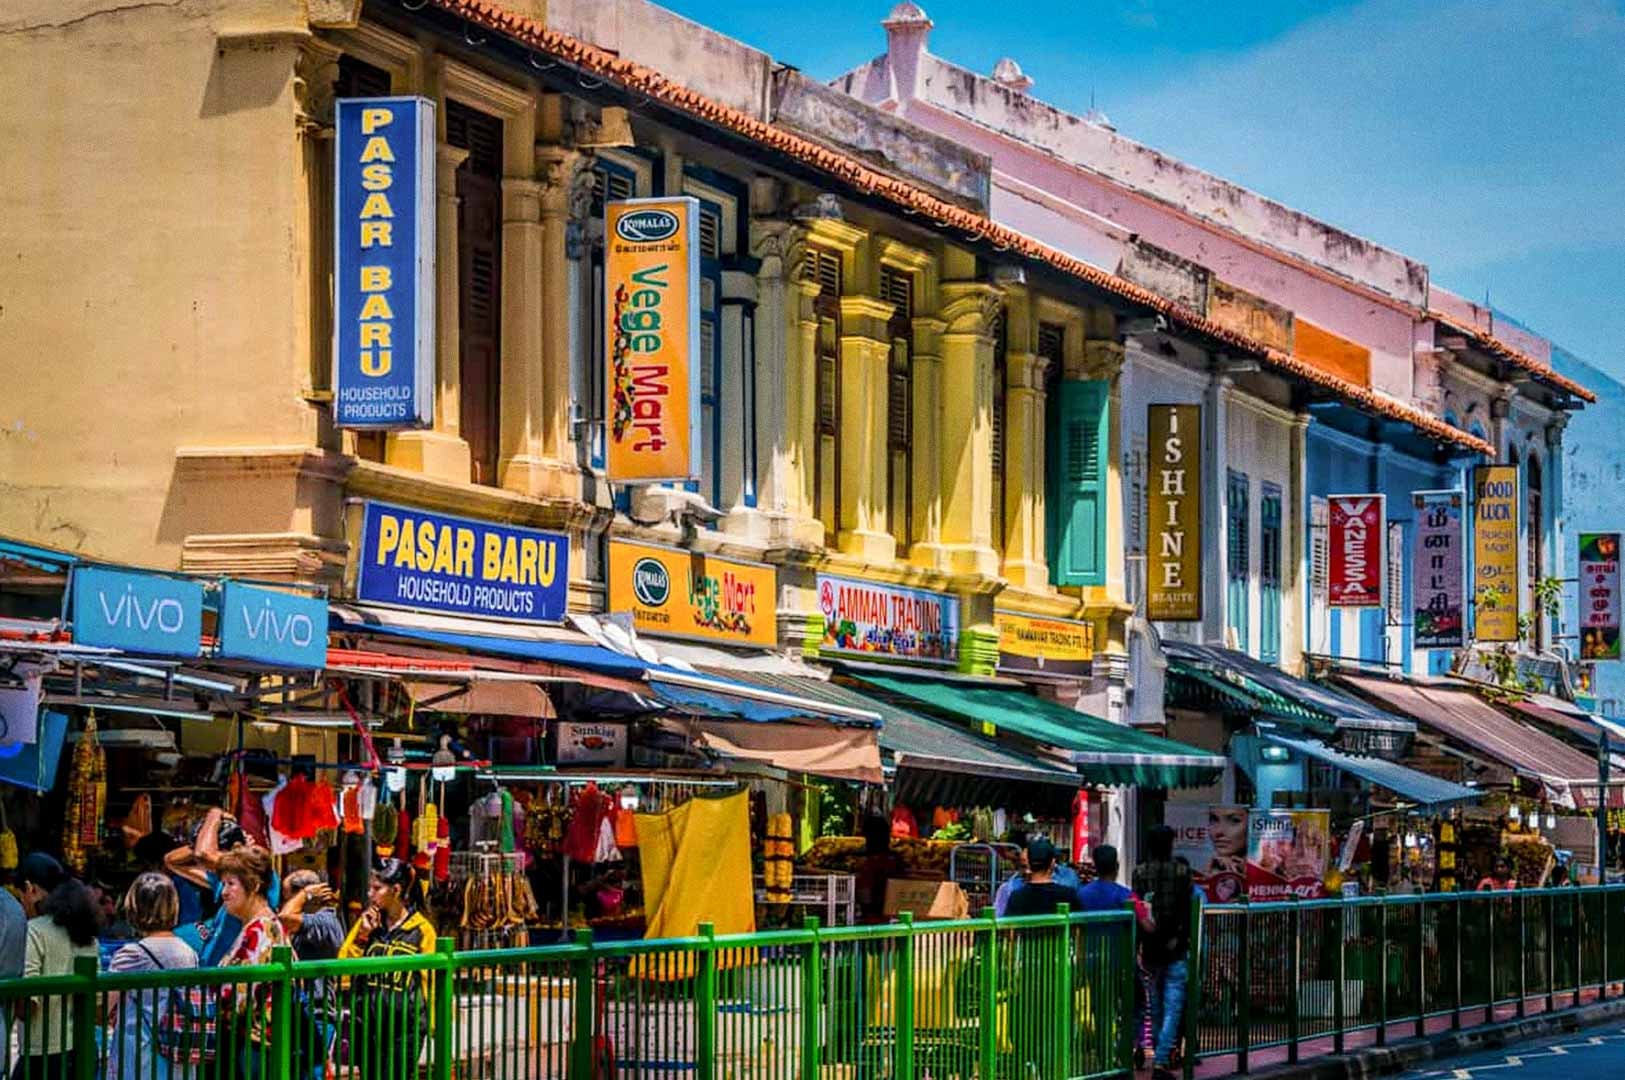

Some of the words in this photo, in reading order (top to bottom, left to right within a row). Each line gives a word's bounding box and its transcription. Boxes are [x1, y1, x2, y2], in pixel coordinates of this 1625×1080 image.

[359, 108, 396, 248] PASAR
[359, 265, 394, 377] BARU
[621, 264, 669, 353] Vege
[340, 386, 411, 401] HOUSEHOLD
[344, 403, 407, 418] PRODUCTS
[632, 365, 669, 452] Mart
[1160, 408, 1186, 588] iSHINE
[1478, 481, 1513, 498] GOOD
[1481, 503, 1511, 520] LUCK
[376, 514, 476, 578] PASAR
[482, 532, 557, 588] BARU
[1335, 499, 1373, 594] VANESSA
[99, 583, 184, 633] vivo
[397, 576, 471, 606] HOUSEHOLD
[473, 586, 534, 614] PRODUCTS
[688, 563, 720, 621] Vege
[724, 571, 755, 614] Mart
[838, 586, 888, 627] AMMAN
[891, 595, 941, 635] TRADING
[242, 598, 313, 647] vivo
[1249, 884, 1294, 897] HENNA
[1296, 881, 1323, 898] art
